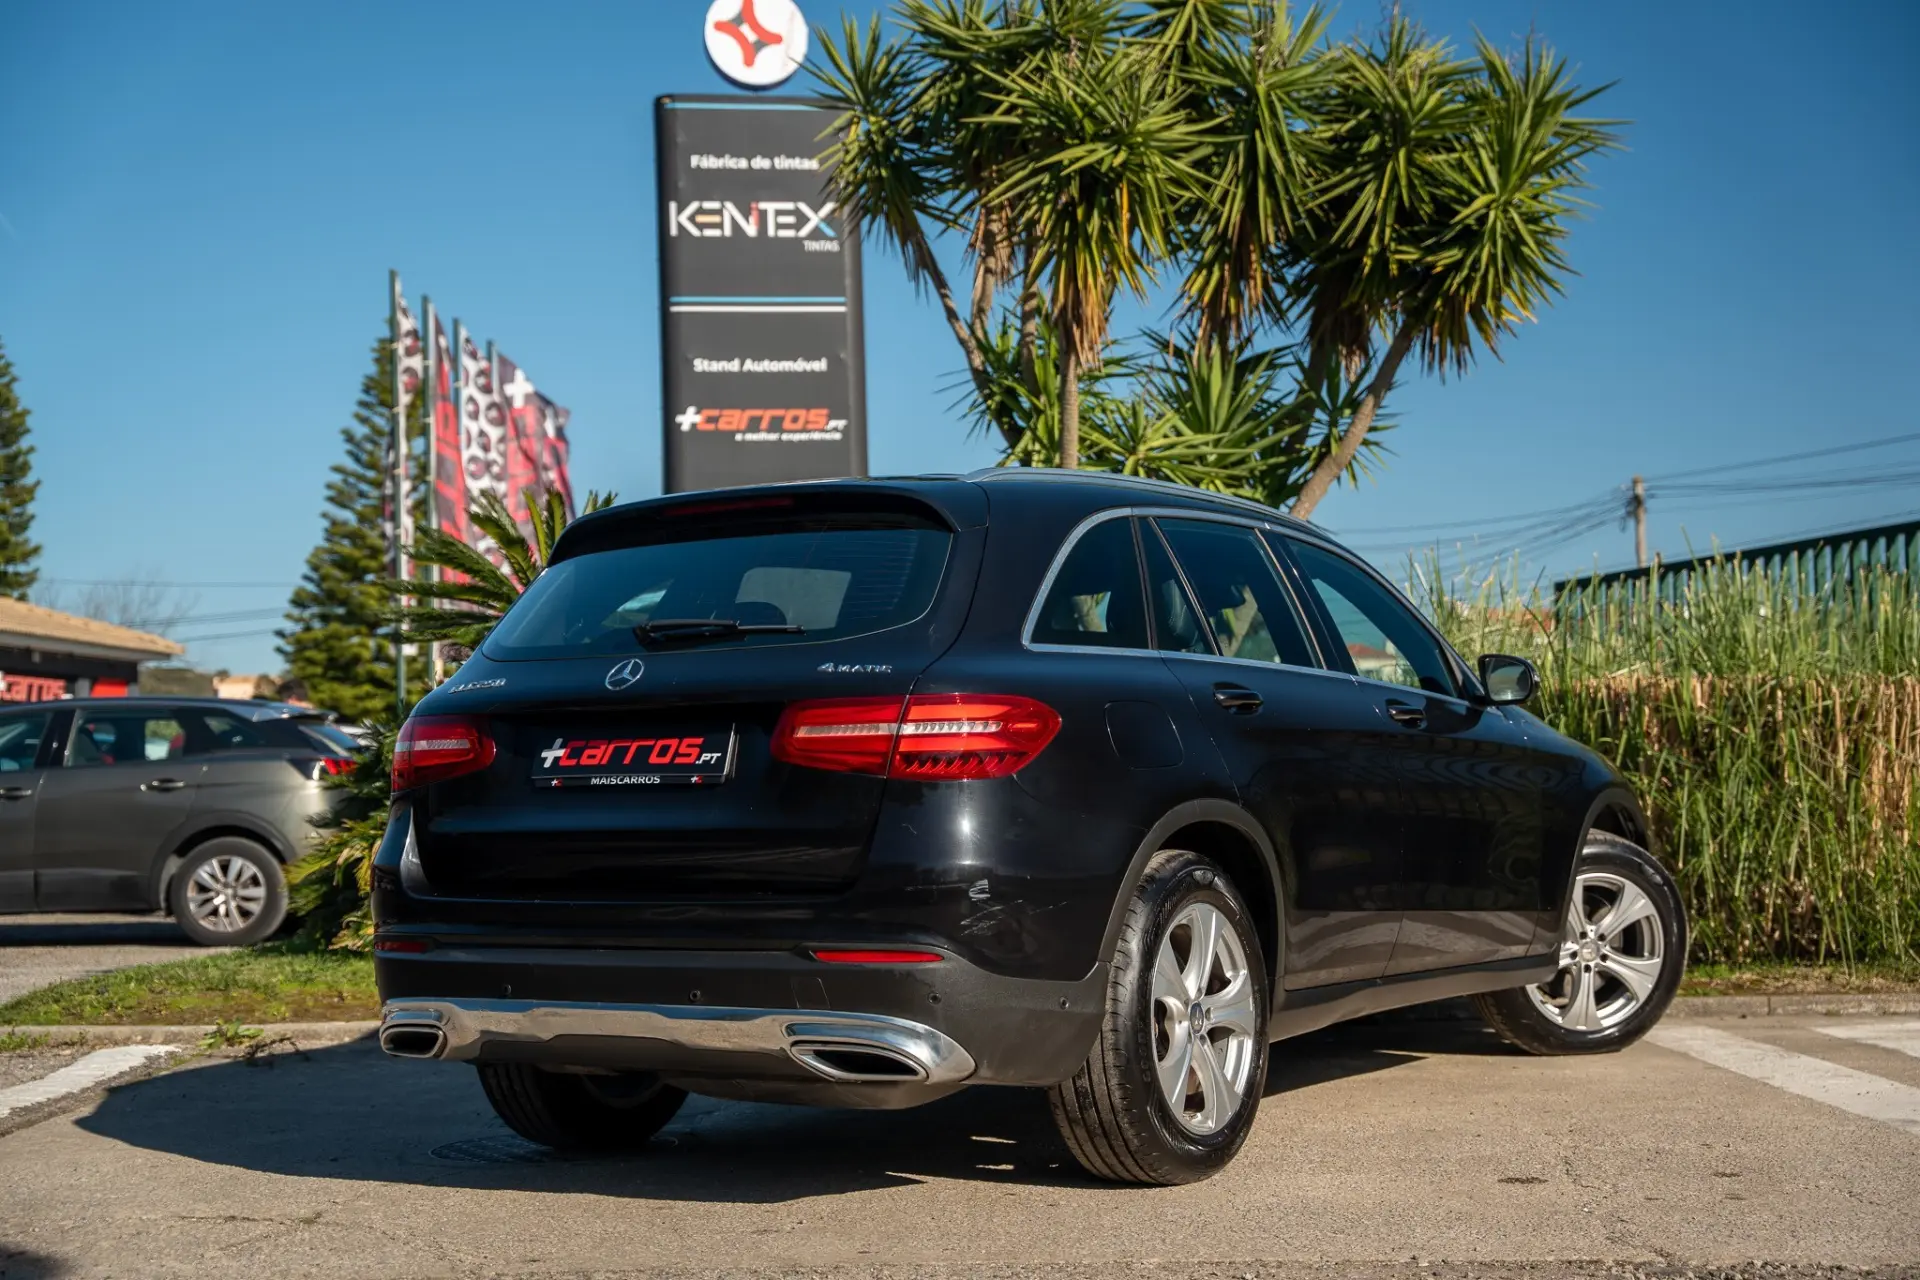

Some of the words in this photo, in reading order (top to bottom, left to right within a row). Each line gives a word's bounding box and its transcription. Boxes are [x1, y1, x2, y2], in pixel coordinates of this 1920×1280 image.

[690, 153, 749, 170] Fábrica
[750, 154, 773, 170] de
[773, 154, 820, 171] tintas
[668, 201, 837, 238] KENTEX
[802, 240, 840, 252] TINTAS
[693, 357, 741, 373] Stand
[742, 357, 828, 373] Automóvel
[590, 775, 661, 786] MAISCARROS
